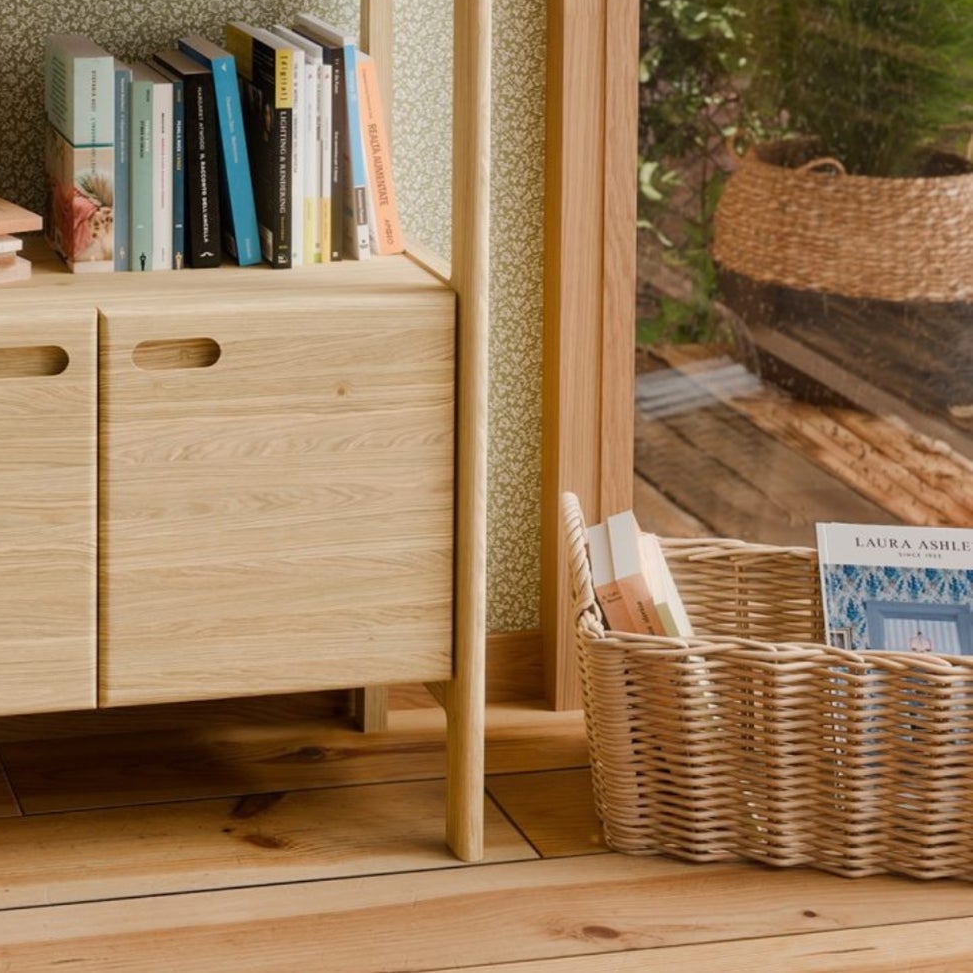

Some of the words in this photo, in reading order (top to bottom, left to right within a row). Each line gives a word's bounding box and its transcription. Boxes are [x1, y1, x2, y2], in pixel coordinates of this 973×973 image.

[279, 111, 288, 154] LIGHTING
[366, 123, 384, 155] REALTÀ
[279, 164, 287, 214] RENDERING
[371, 156, 390, 207] AUMENTATE
[201, 197, 209, 243] DELL'ANCELLA
[855, 537, 912, 549] LAURA
[918, 540, 973, 552] ASHLE
